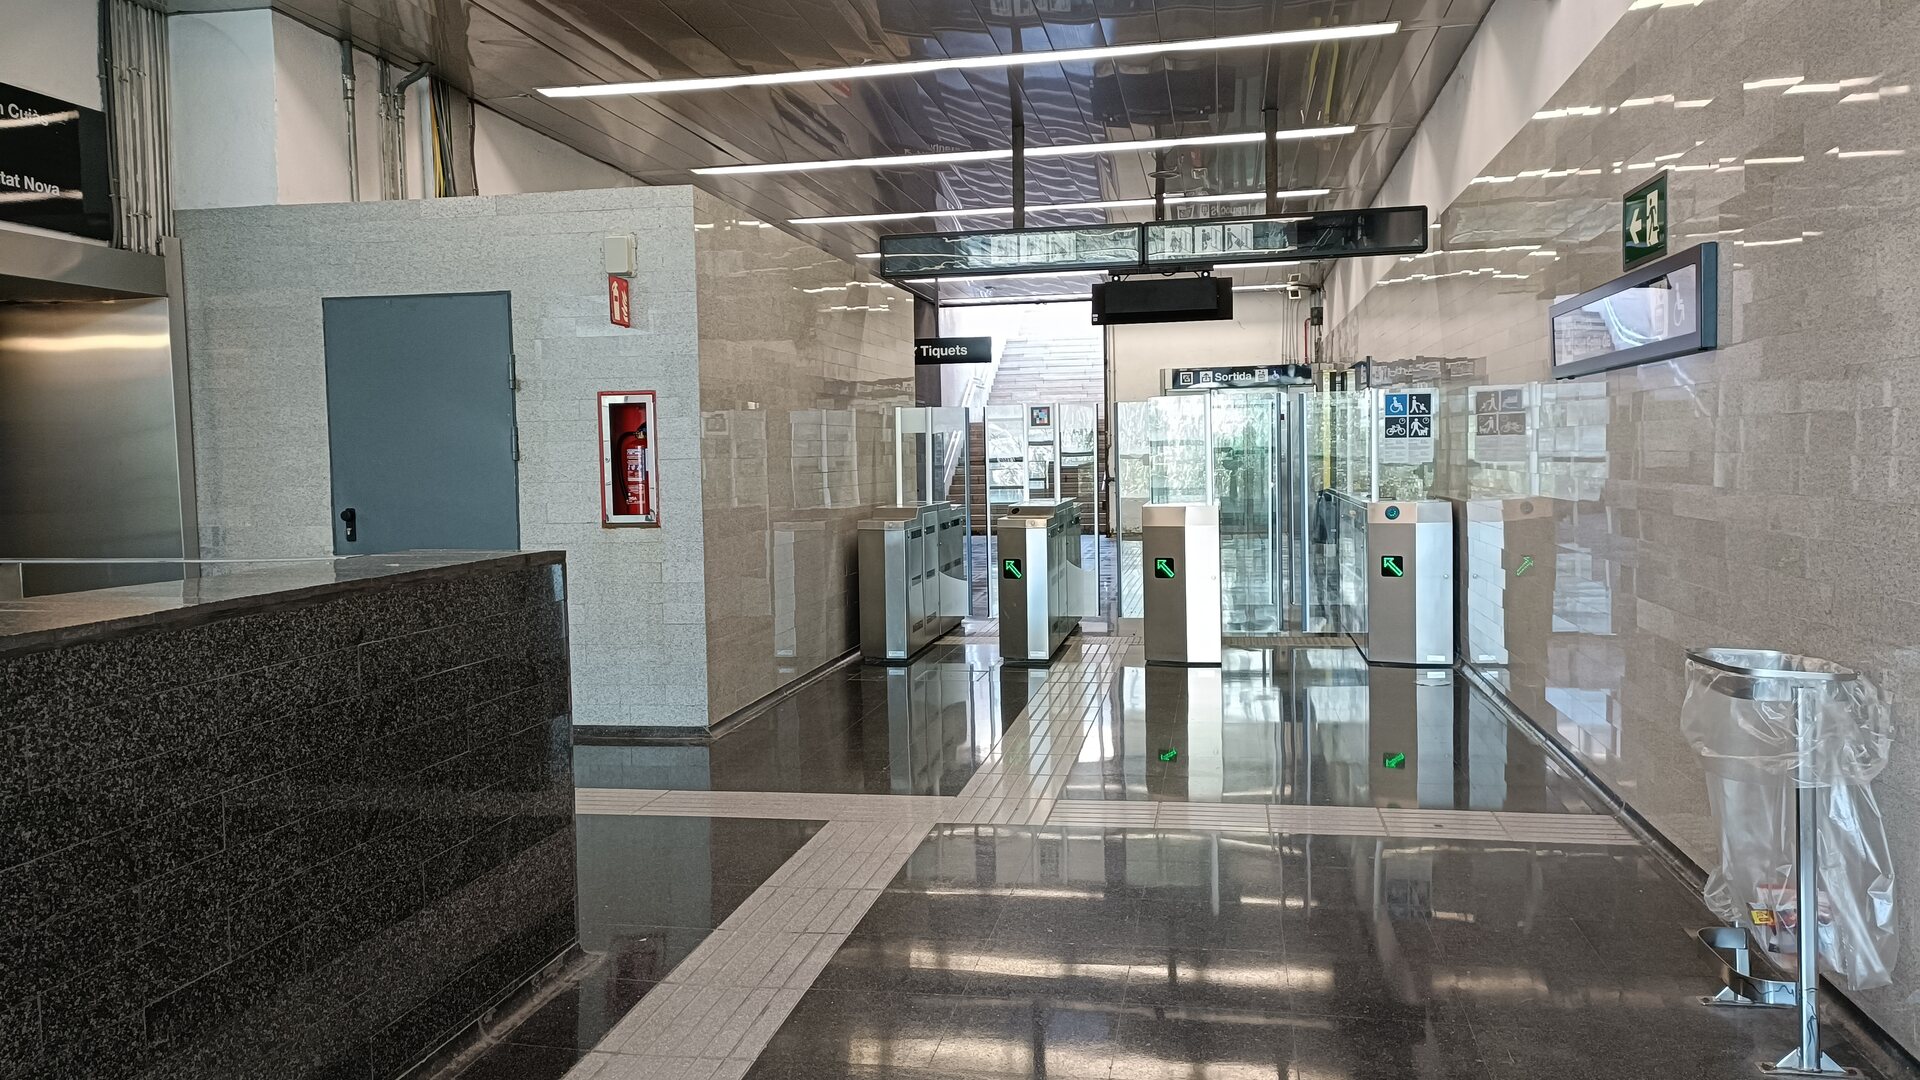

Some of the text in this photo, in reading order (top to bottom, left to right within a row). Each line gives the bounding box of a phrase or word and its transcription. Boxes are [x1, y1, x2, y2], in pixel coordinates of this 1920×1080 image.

[24, 175, 60, 196] Nova
[920, 345, 968, 358] Tiquets
[1214, 372, 1252, 381] Sortida
